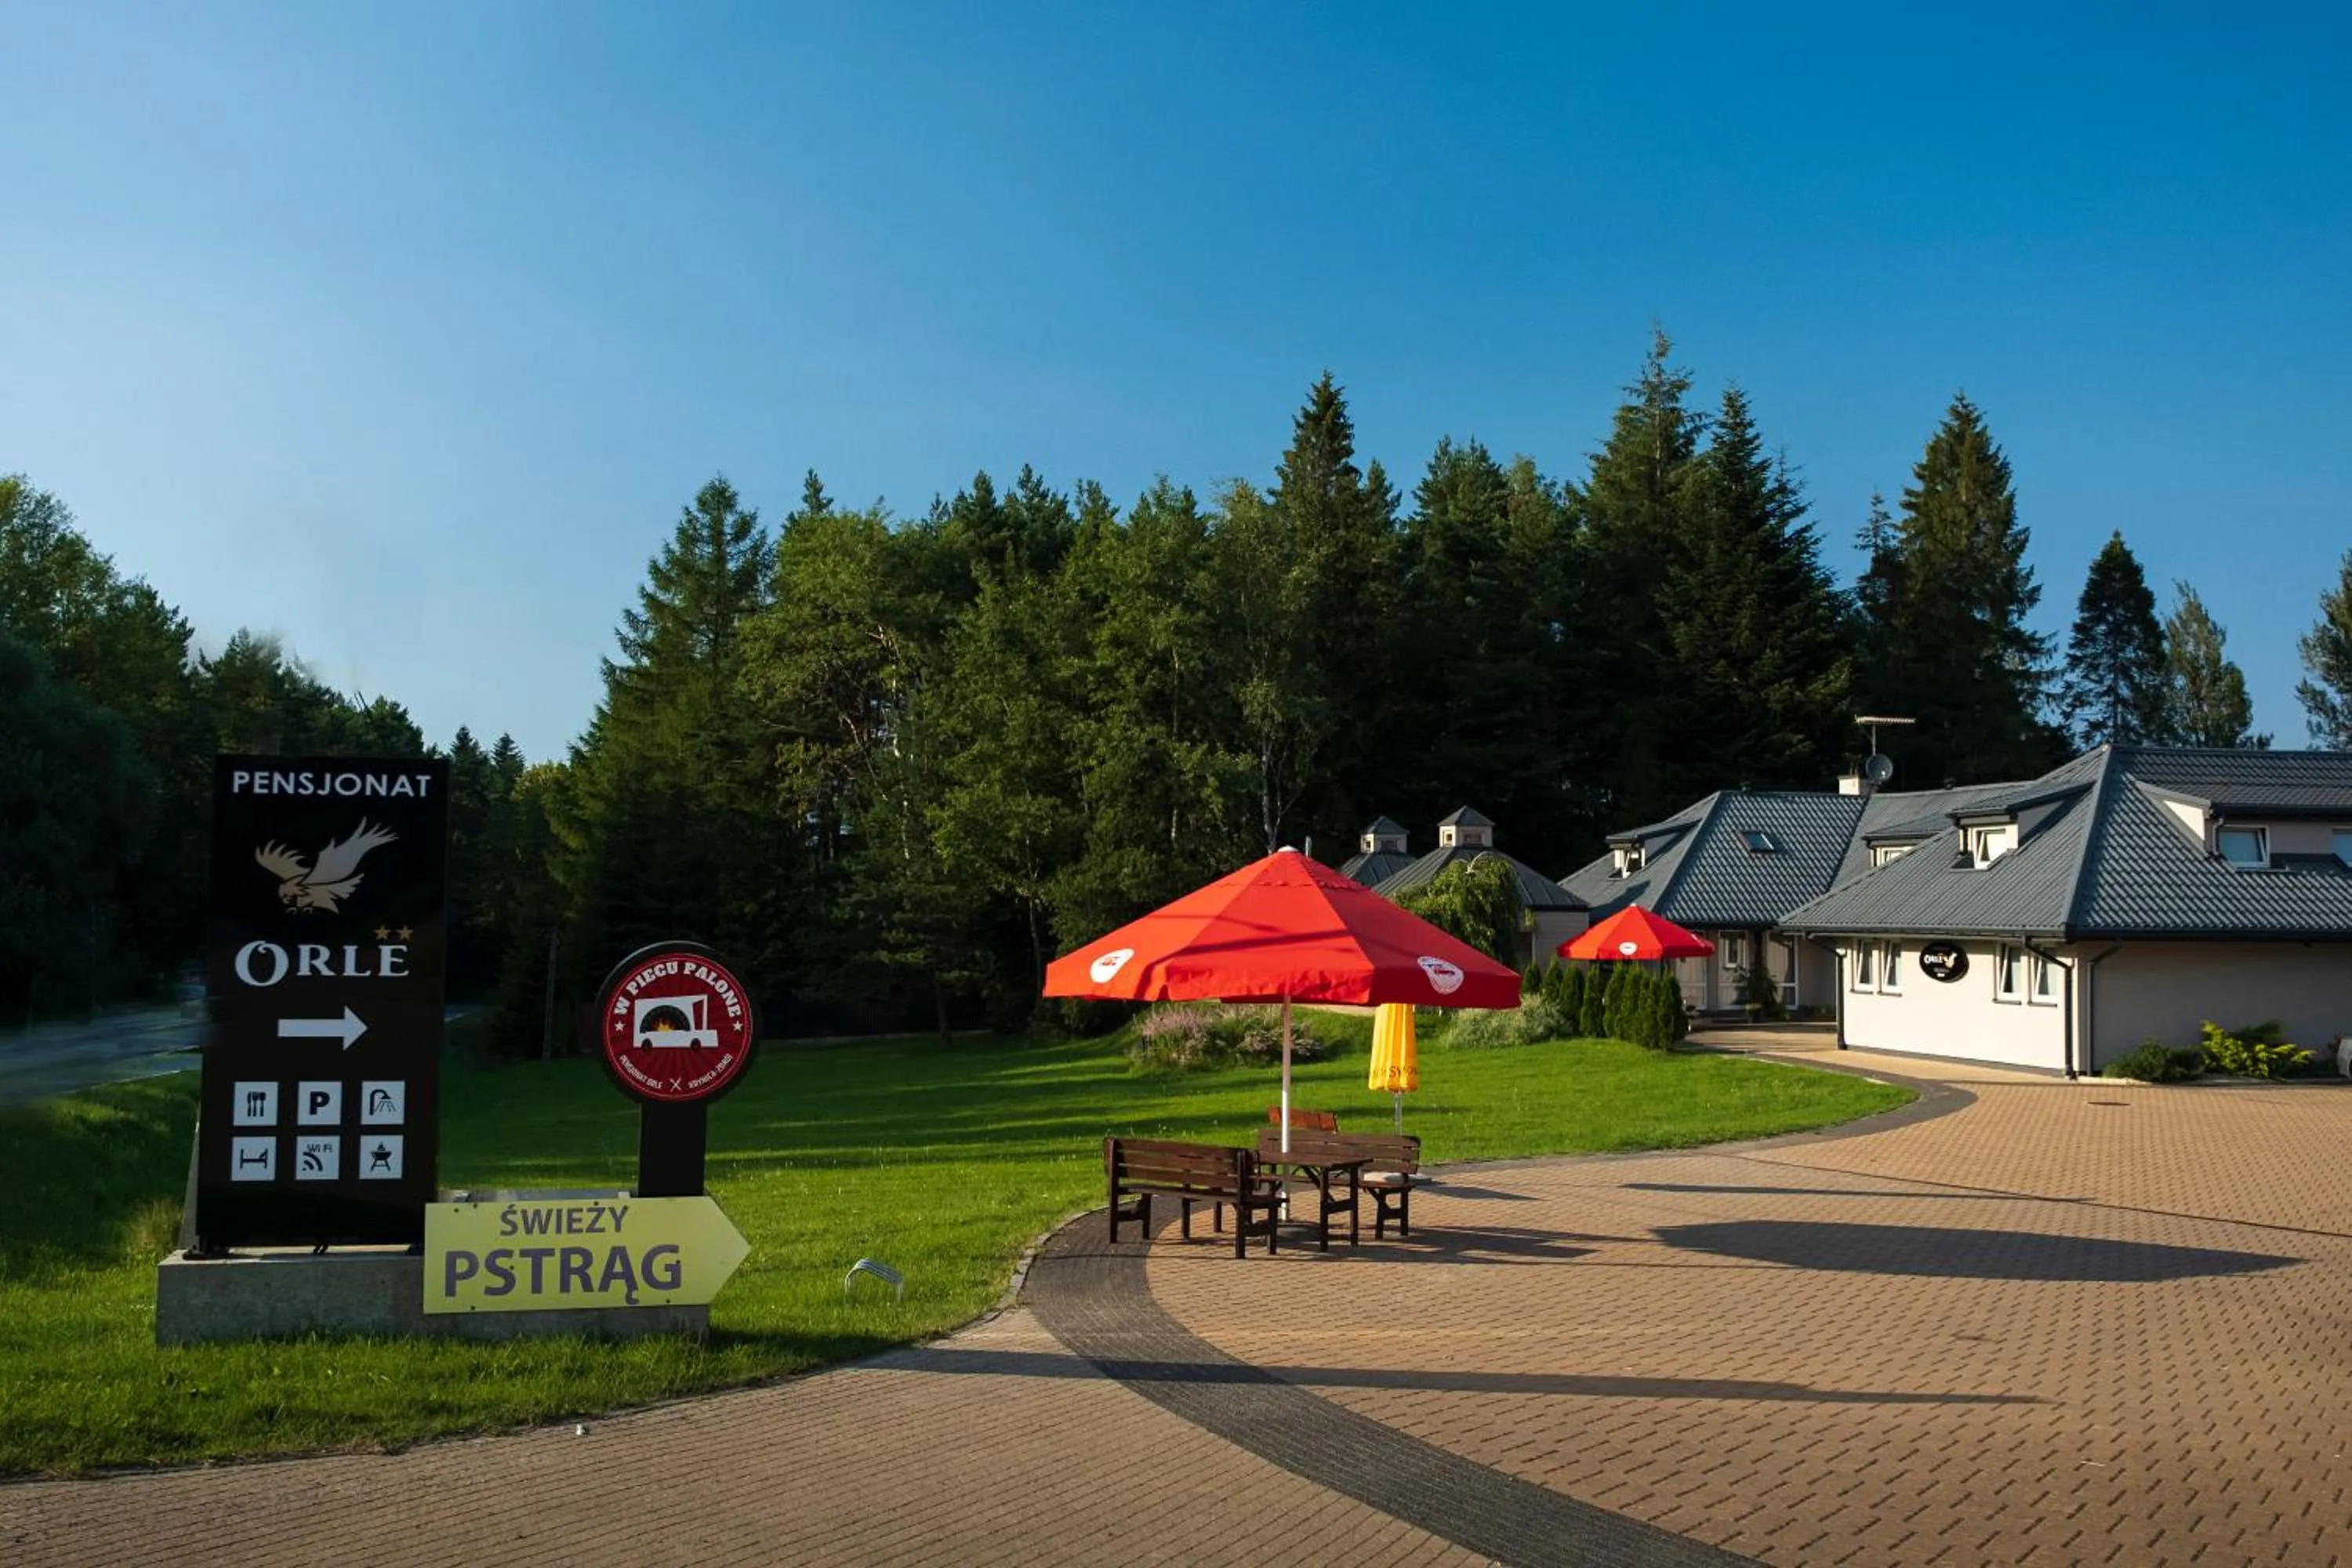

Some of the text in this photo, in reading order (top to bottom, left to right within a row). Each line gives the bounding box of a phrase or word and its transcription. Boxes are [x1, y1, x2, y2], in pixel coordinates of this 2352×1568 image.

[232, 771, 431, 797] PENSJONAT
[234, 940, 410, 987] ORLE
[614, 960, 742, 1018] W PIECU PALONE
[309, 1091, 330, 1116] P
[500, 1204, 629, 1236] ŚWIEŻY
[445, 1244, 681, 1305] PSTRĄG
